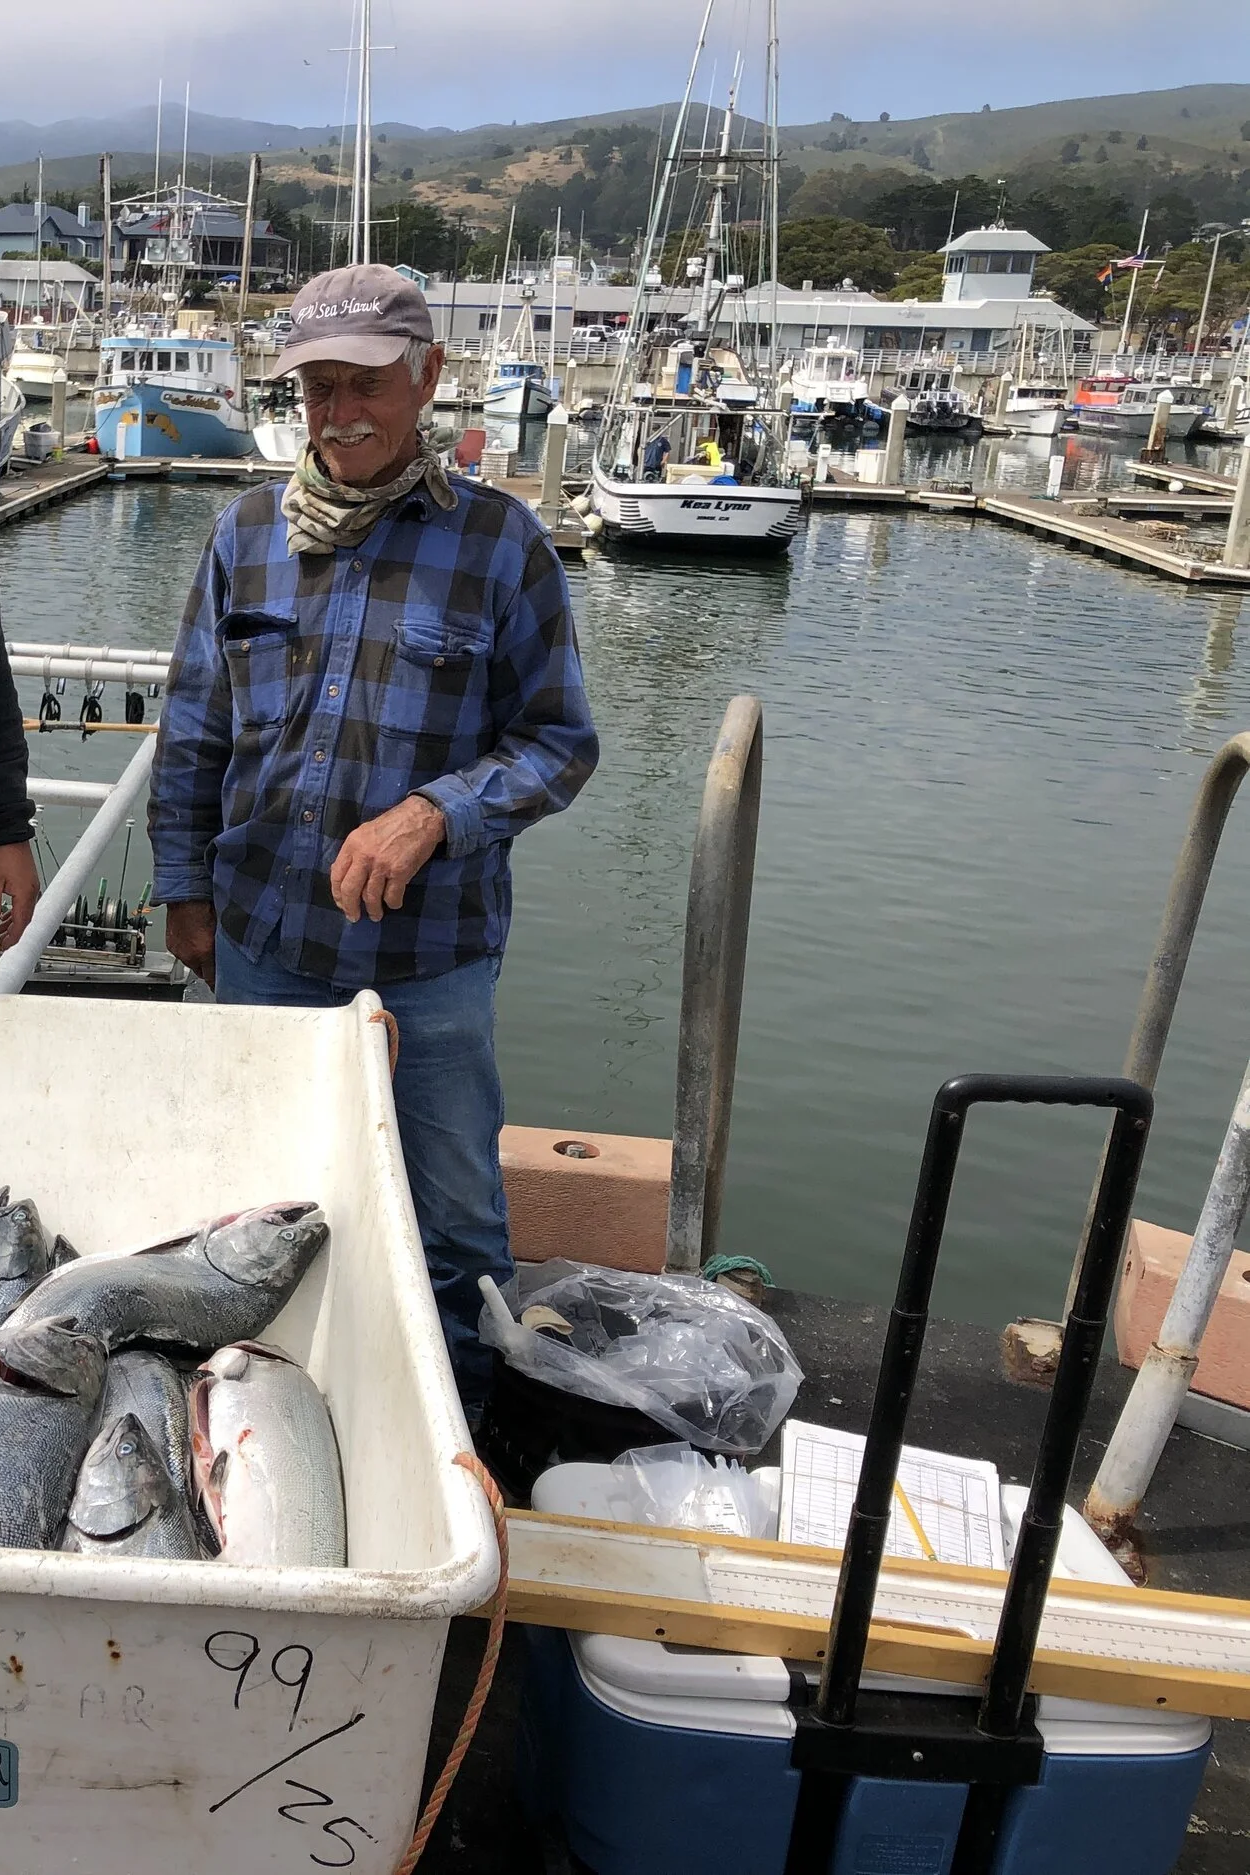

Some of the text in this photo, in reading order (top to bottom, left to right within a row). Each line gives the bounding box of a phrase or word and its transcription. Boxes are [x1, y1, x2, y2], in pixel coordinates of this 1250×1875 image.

[316, 303, 338, 319] Sea
[340, 296, 384, 315] Hawk
[680, 499, 752, 512] Kea Lynn
[205, 1631, 313, 1732] 99
